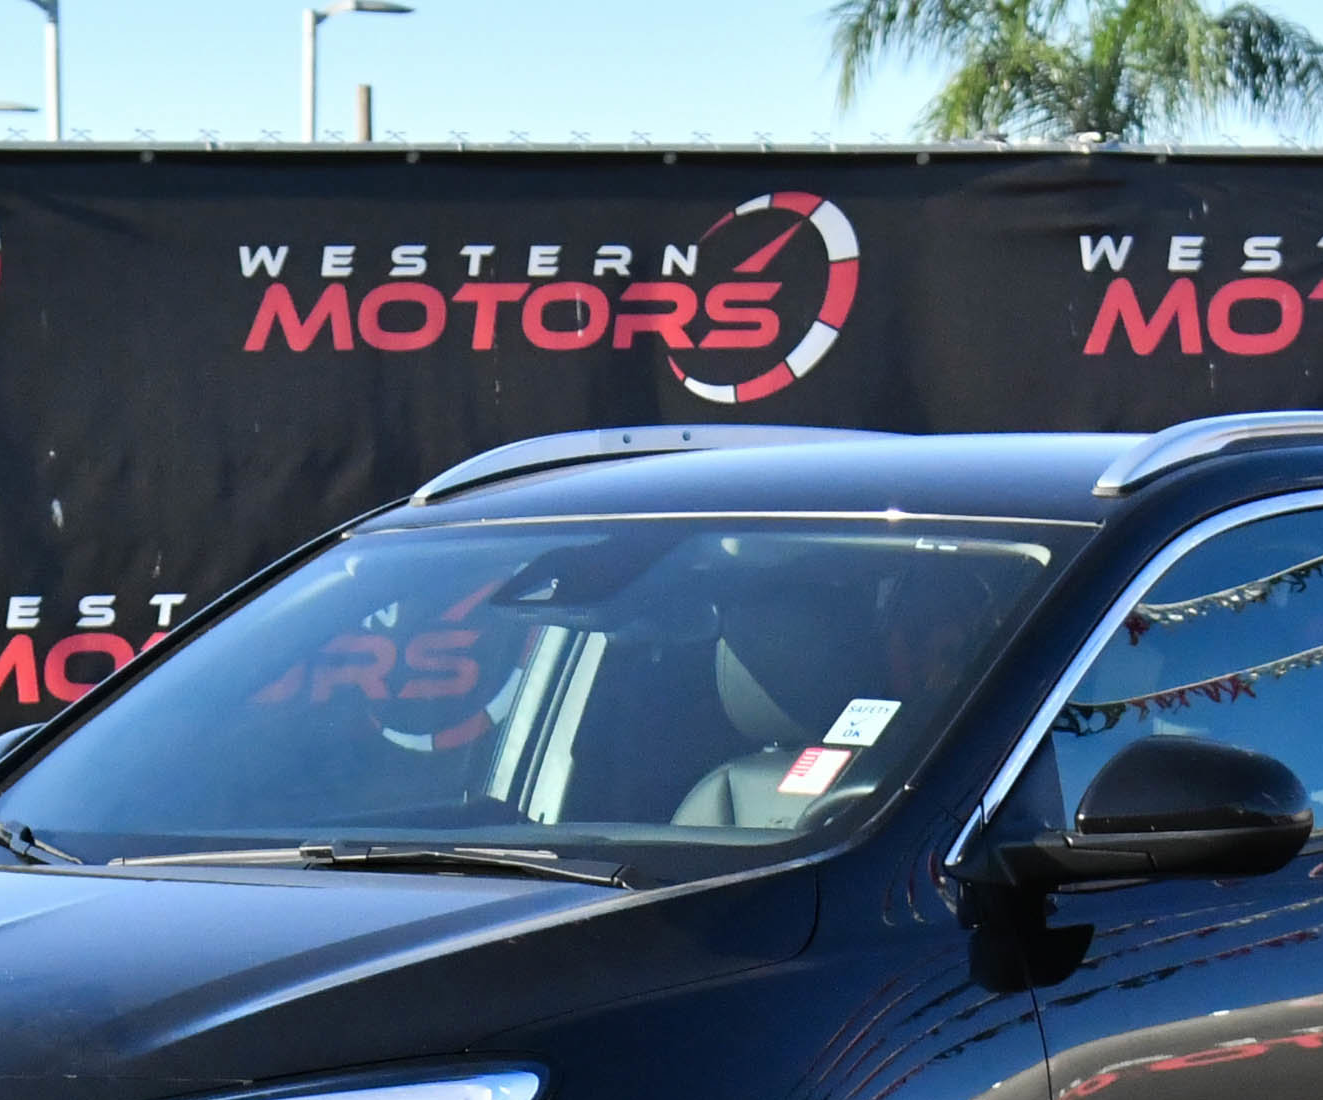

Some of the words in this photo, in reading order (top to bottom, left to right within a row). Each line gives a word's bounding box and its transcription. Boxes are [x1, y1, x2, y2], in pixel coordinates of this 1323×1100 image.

[239, 244, 698, 278] WESTERN
[243, 281, 783, 353] MOTORS
[847, 704, 891, 714] SAFETY
